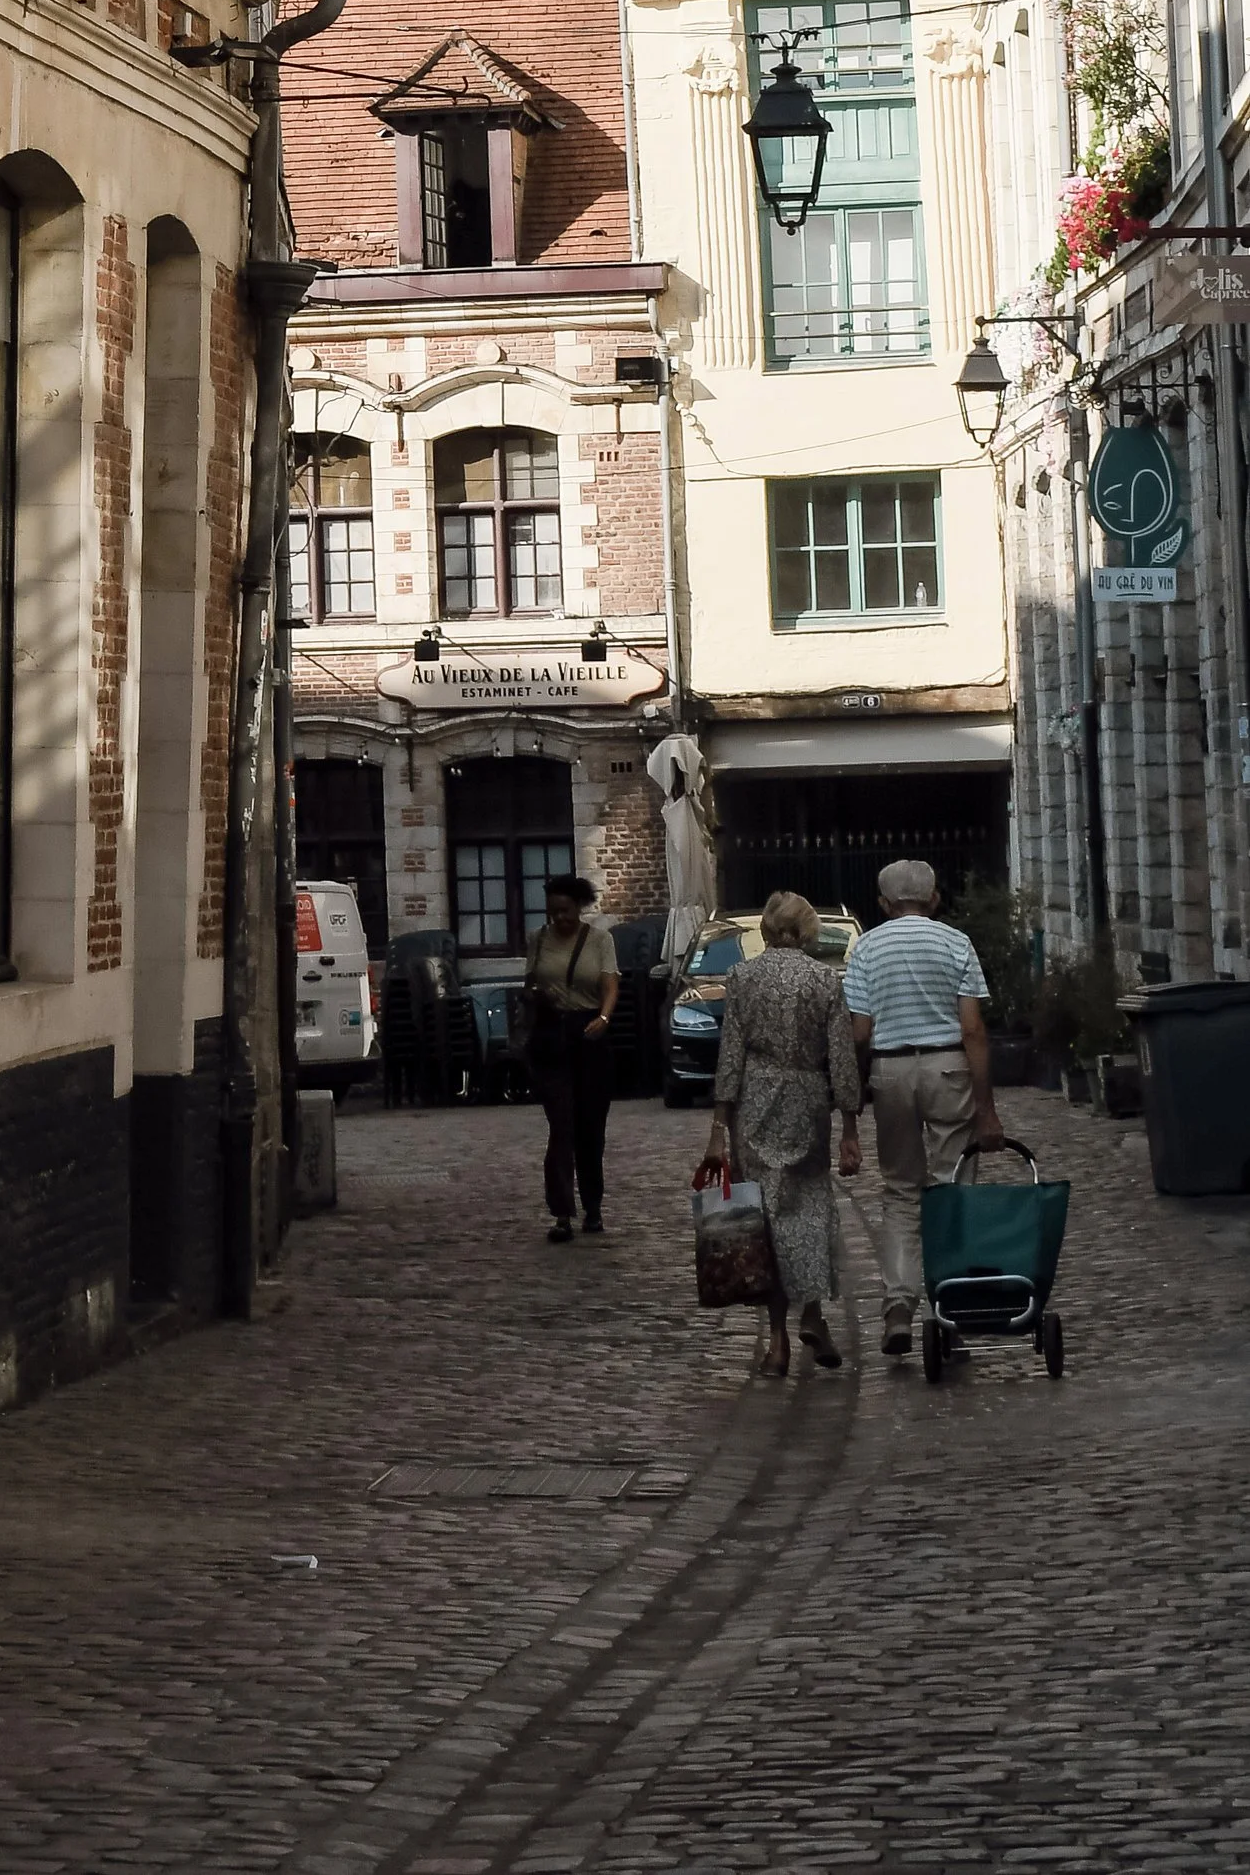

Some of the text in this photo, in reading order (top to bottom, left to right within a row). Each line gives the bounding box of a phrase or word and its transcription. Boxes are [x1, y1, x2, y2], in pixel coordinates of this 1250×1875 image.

[1098, 575, 1111, 590] AU
[1141, 575, 1153, 590] DU
[1158, 575, 1174, 590] VIN
[500, 667, 524, 682] DE
[530, 667, 551, 682] LA
[461, 686, 531, 698] ESTAMINET
[548, 686, 578, 696] CAFE
[867, 697, 875, 706] 6
